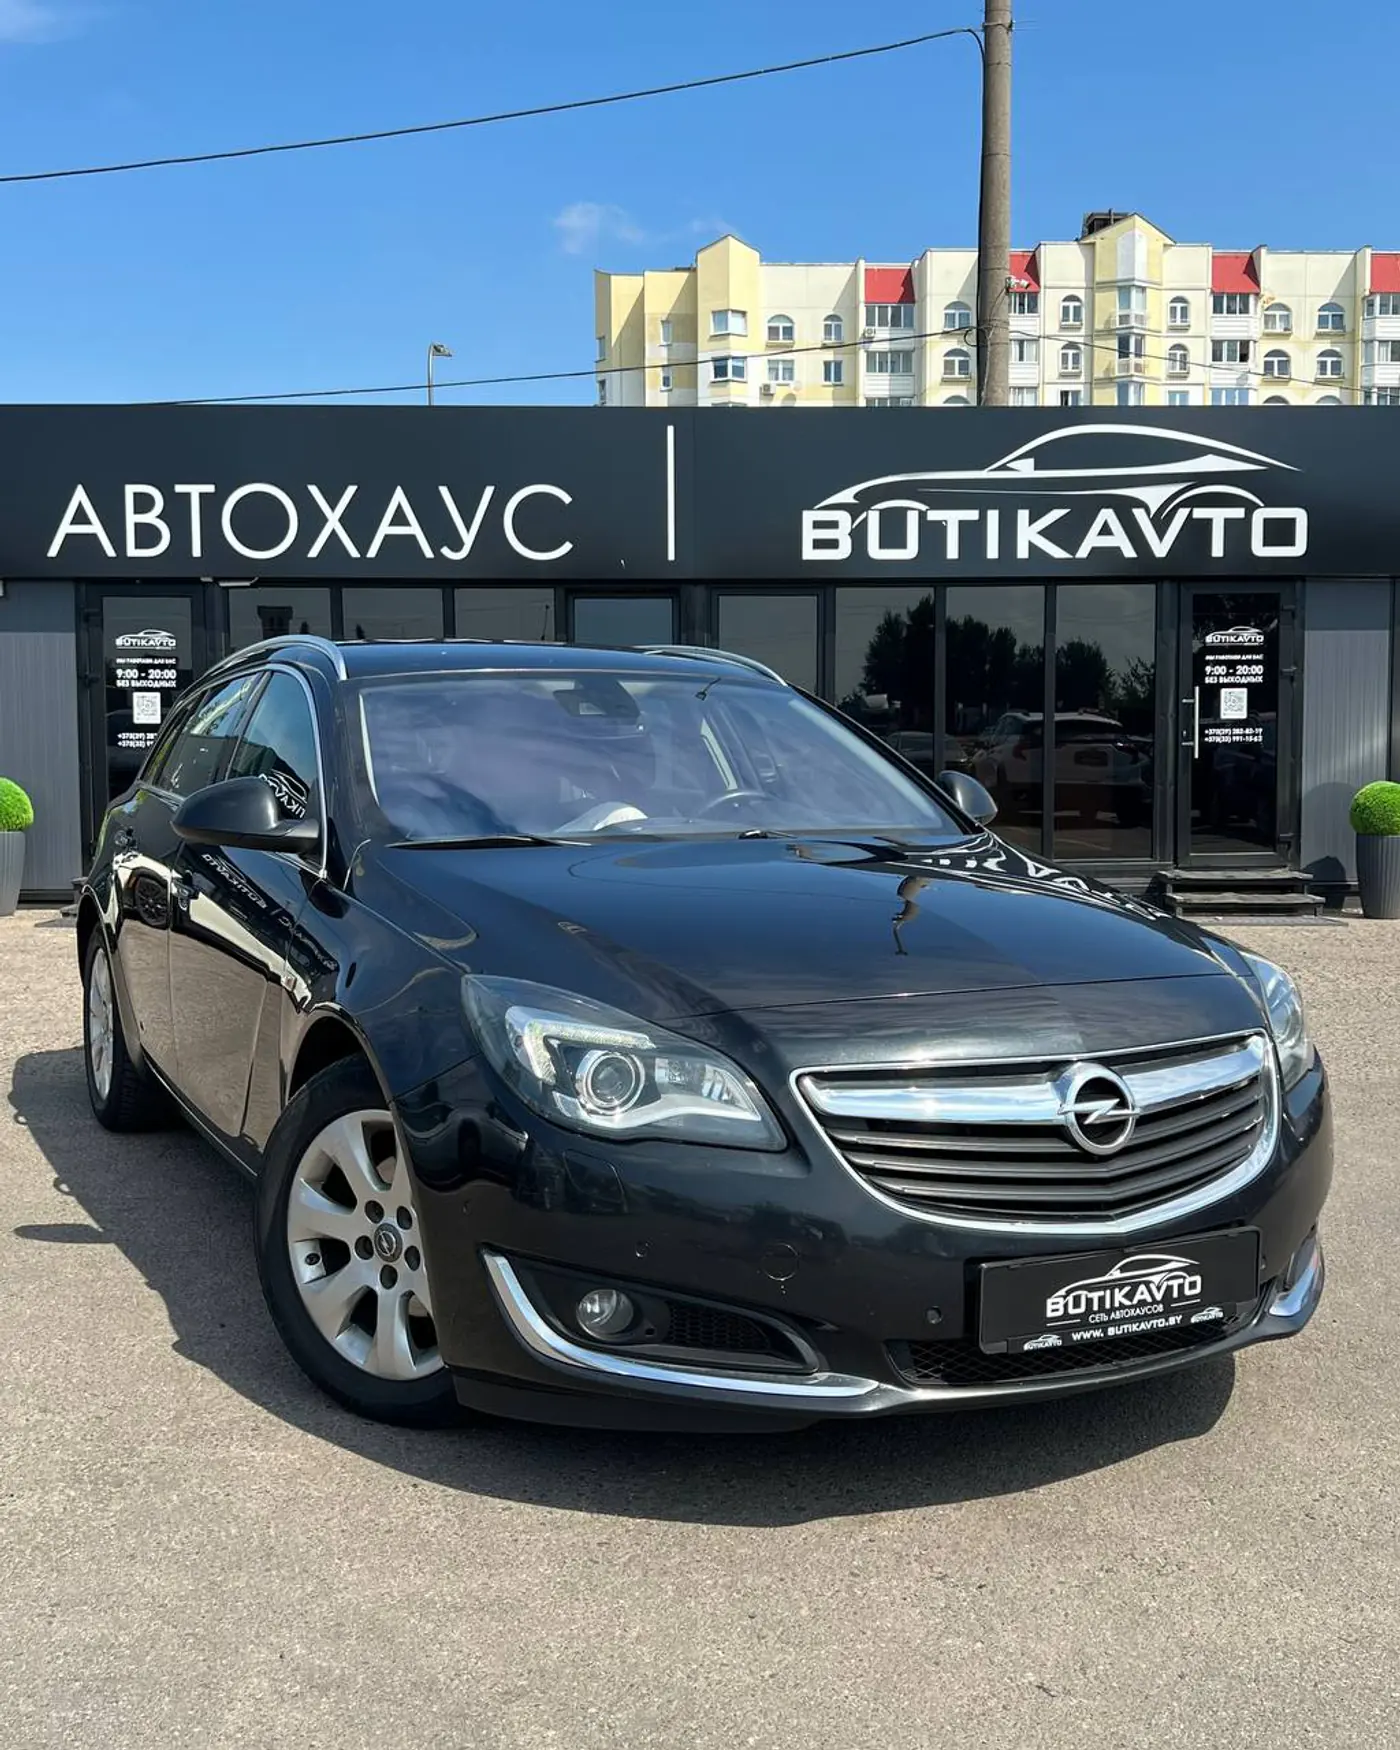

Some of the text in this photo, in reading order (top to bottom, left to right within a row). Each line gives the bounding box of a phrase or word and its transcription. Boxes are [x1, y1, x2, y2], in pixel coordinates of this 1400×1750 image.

[47, 482, 574, 560] АВТОХАУС
[801, 505, 1309, 561] BUTIKAVTO
[116, 638, 176, 647] BUTIKAVTO
[1205, 634, 1264, 643] BUTIKAVTO
[116, 669, 138, 678] 9:00
[148, 669, 177, 679] 20:00
[1205, 665, 1227, 675] 9:00
[1236, 665, 1264, 675] 20:00
[1046, 1274, 1202, 1318] BUTIKAVTO
[1088, 1304, 1164, 1324] СЕТЬ АВТОХАУСОВ
